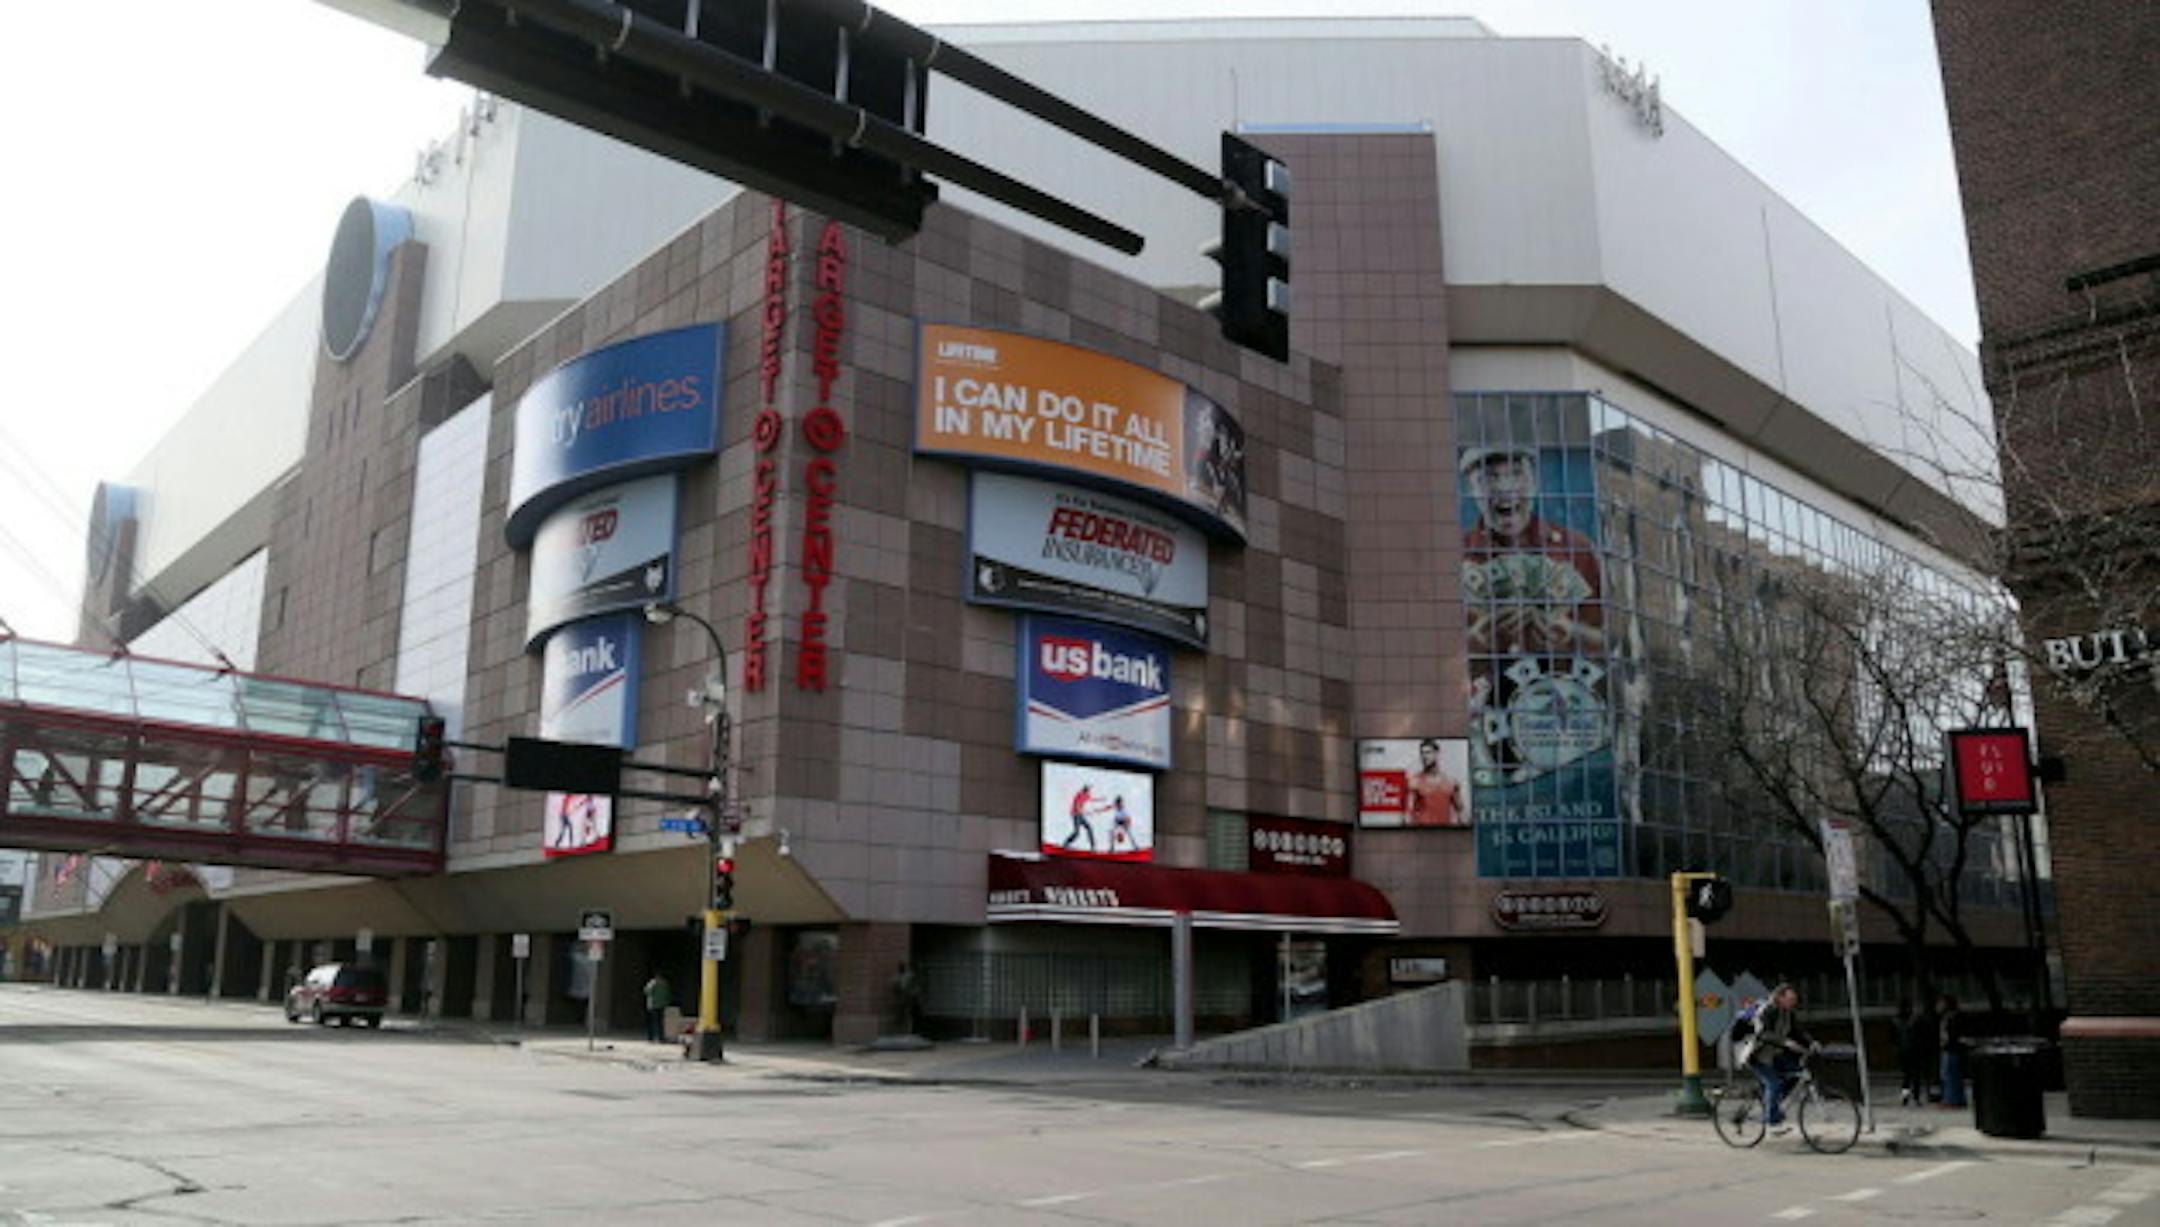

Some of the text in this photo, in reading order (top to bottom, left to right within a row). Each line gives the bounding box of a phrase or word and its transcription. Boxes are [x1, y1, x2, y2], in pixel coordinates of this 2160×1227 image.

[586, 375, 701, 430] airlines
[935, 375, 1170, 451] I CAN DO IT ALL
[744, 197, 786, 693] TARGET CENTER
[796, 219, 846, 694] ARGET CENTER
[935, 406, 1170, 477] IN MY LIFETIME
[1048, 506, 1175, 566] FEDERATED
